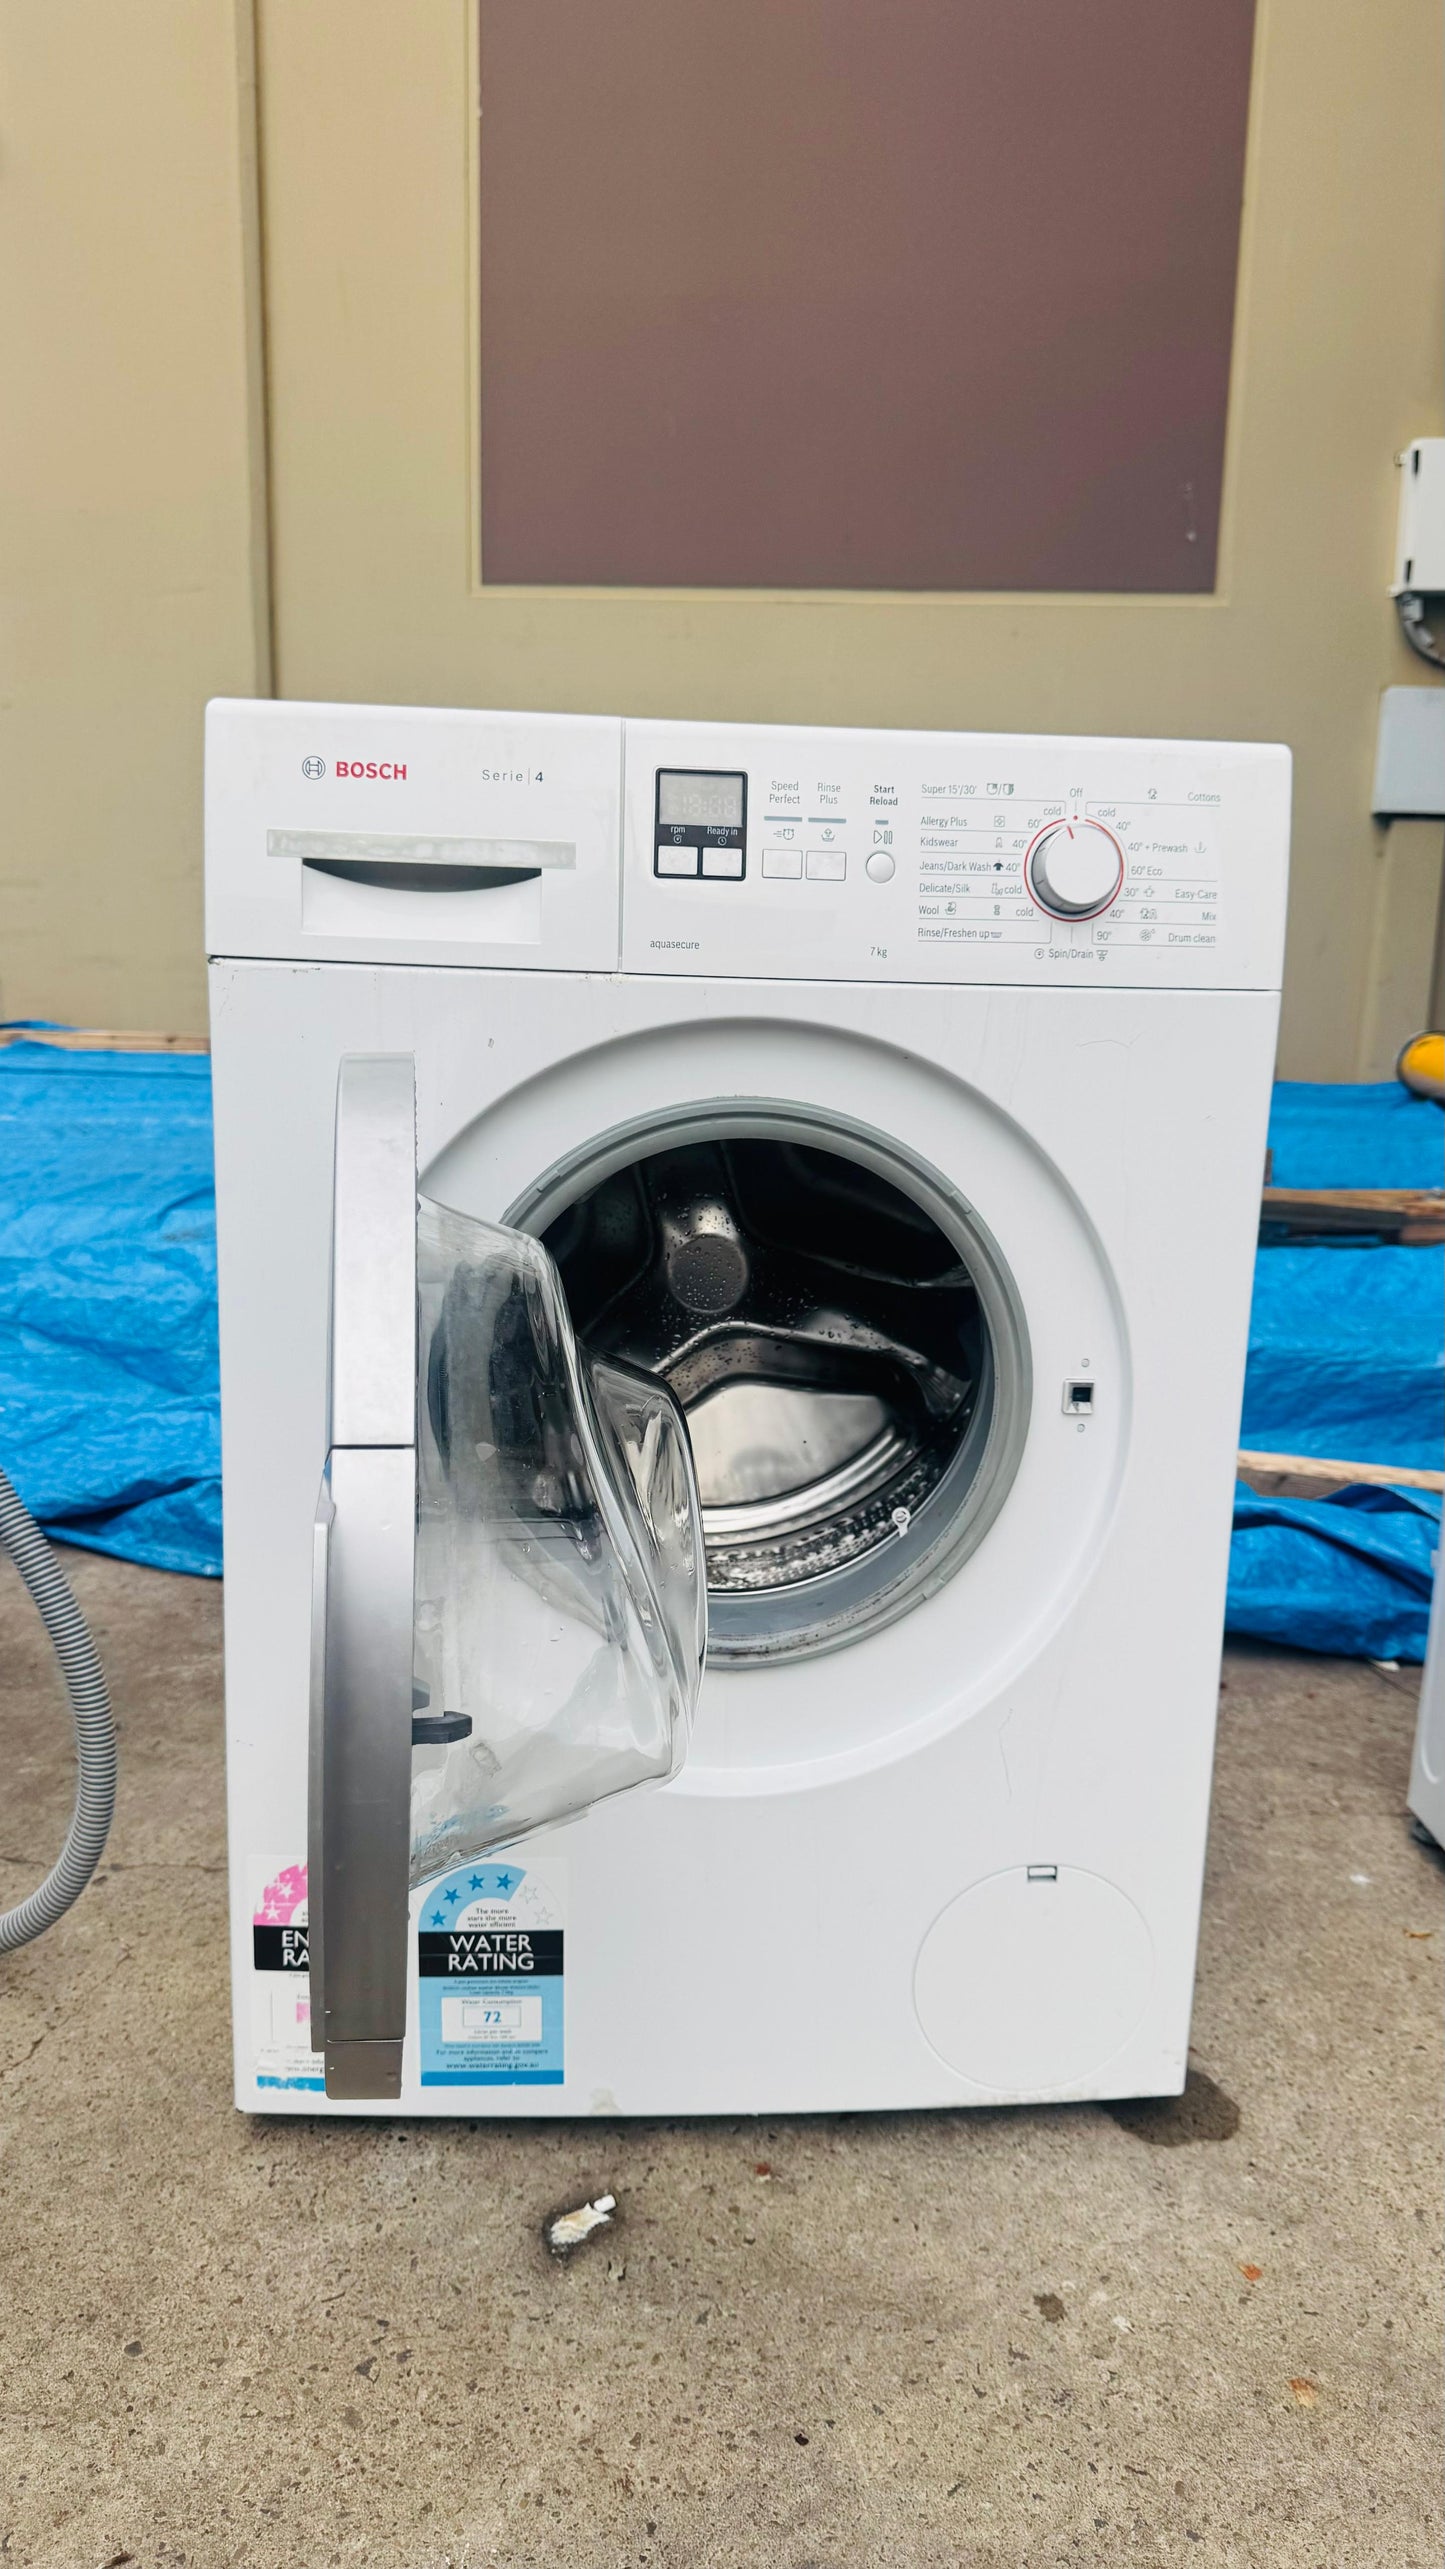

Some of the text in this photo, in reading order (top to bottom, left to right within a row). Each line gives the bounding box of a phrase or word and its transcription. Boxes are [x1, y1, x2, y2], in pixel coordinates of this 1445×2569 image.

[335, 761, 408, 781] BOSCH
[481, 768, 544, 783] Serie 4
[771, 780, 799, 792] Speed
[817, 782, 841, 793] Rinse
[873, 784, 895, 794] Start
[921, 784, 946, 795] Super
[1069, 787, 1083, 797] Off
[1187, 792, 1221, 802] Cottons
[769, 793, 800, 805] Perfect
[819, 794, 839, 805] Plus
[869, 796, 898, 806] Reload
[1043, 806, 1062, 816] cold
[1097, 808, 1116, 817] cold
[920, 816, 967, 827] Allergy Plus
[670, 825, 686, 835] rpm
[707, 826, 738, 837] Ready in
[920, 836, 958, 847] Kidswear
[1152, 843, 1188, 853] Prewash
[919, 861, 992, 872] Jeans/Dark Wash
[1147, 866, 1163, 876] Eco
[919, 883, 970, 893] Delicate/Silk
[1004, 885, 1022, 894] cold
[919, 905, 939, 915] Wool
[1015, 907, 1034, 917] cold
[1201, 911, 1217, 921] Mix
[918, 928, 990, 940] Rinse/Freshen up
[1168, 933, 1216, 943] Drum clean
[649, 939, 700, 950] aquasecure
[870, 946, 888, 958] 7 kg
[1048, 948, 1094, 960] Spin/Drain
[449, 1934, 533, 1953] WATER
[448, 1952, 535, 1972] RATING
[483, 2010, 502, 2023] 72
